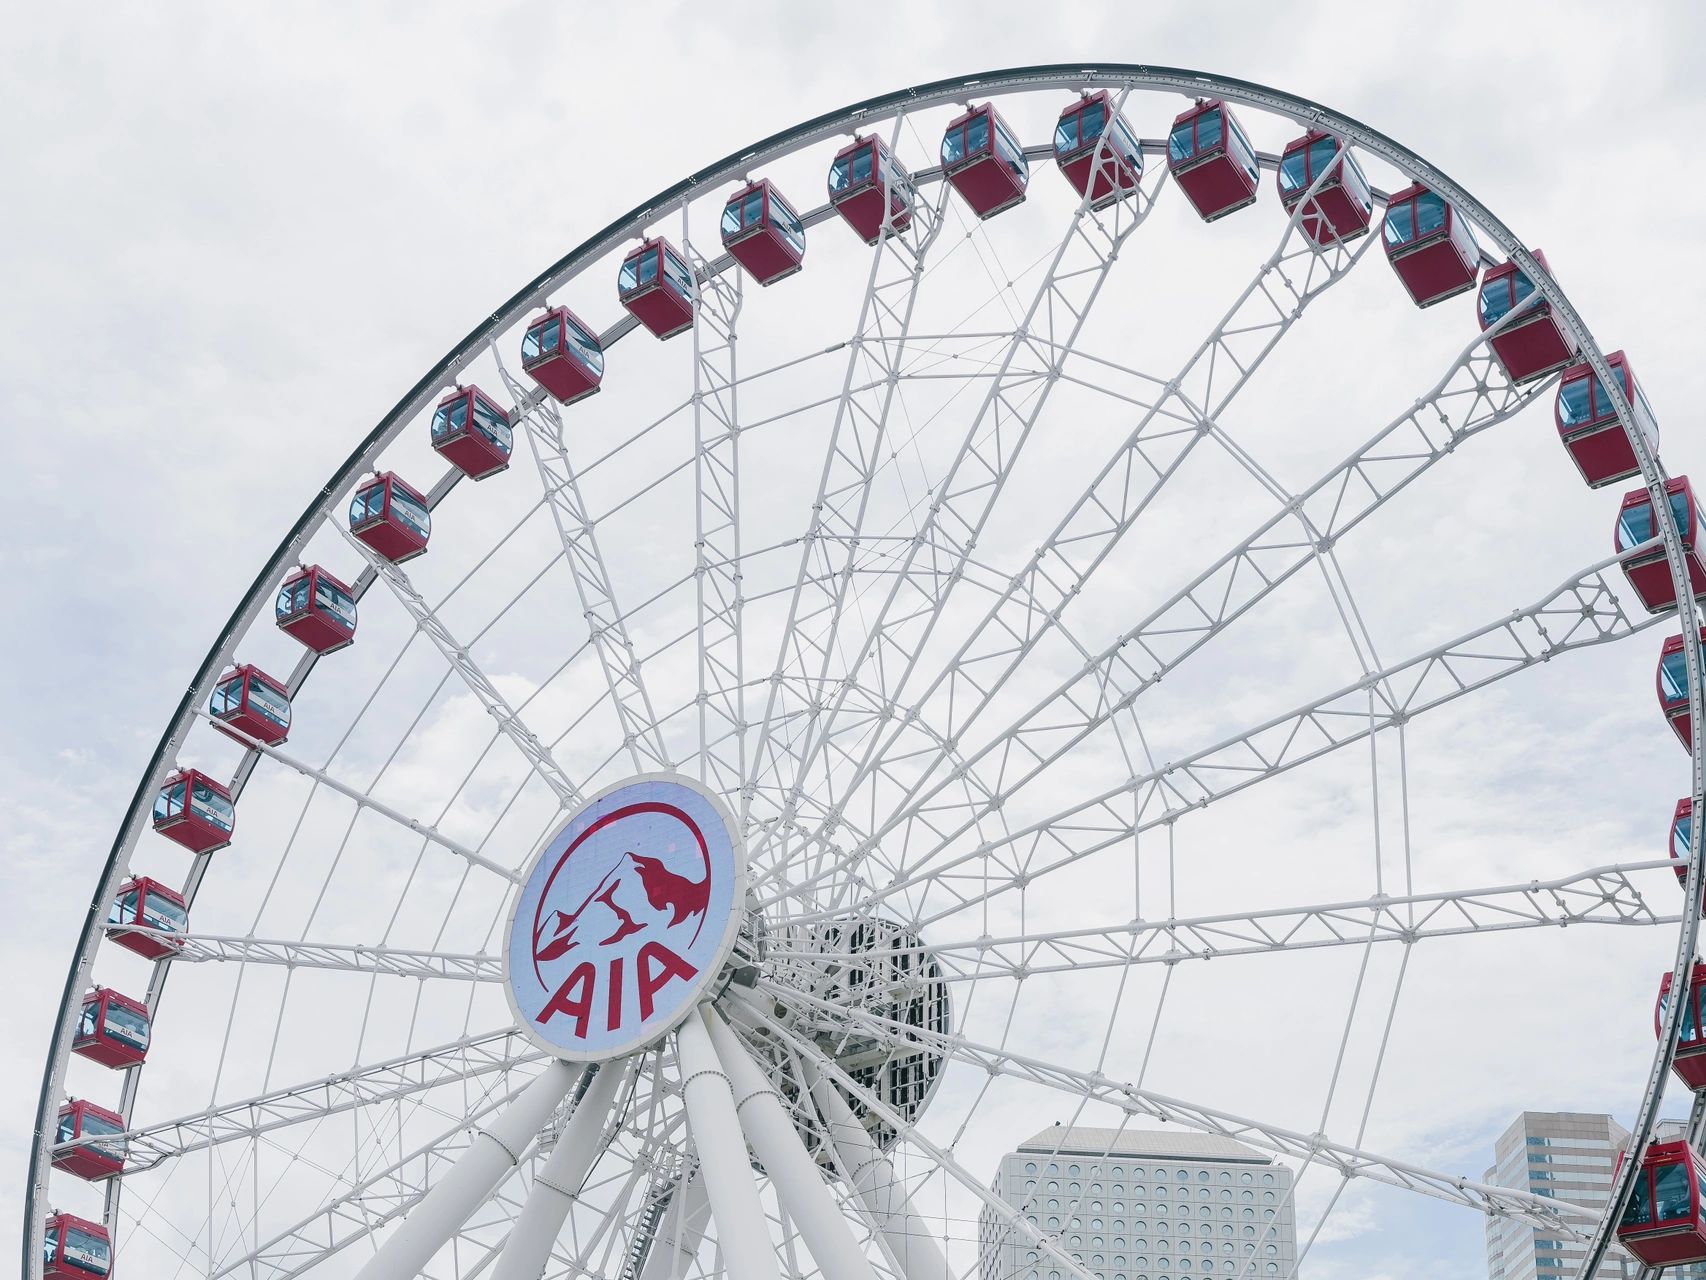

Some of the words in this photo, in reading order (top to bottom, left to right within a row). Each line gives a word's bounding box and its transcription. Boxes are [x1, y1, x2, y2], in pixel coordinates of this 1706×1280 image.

[677, 277, 689, 290] AIA
[579, 346, 590, 358] AIA
[487, 425, 498, 436] AIA
[404, 511, 416, 520] AIA
[330, 603, 342, 613] AIA
[263, 703, 275, 713] AIA
[206, 807, 218, 817] AIA
[159, 915, 171, 925] AIA
[535, 940, 699, 1039] AIA
[120, 1028, 133, 1038] AIA
[80, 1254, 93, 1263] AIA
